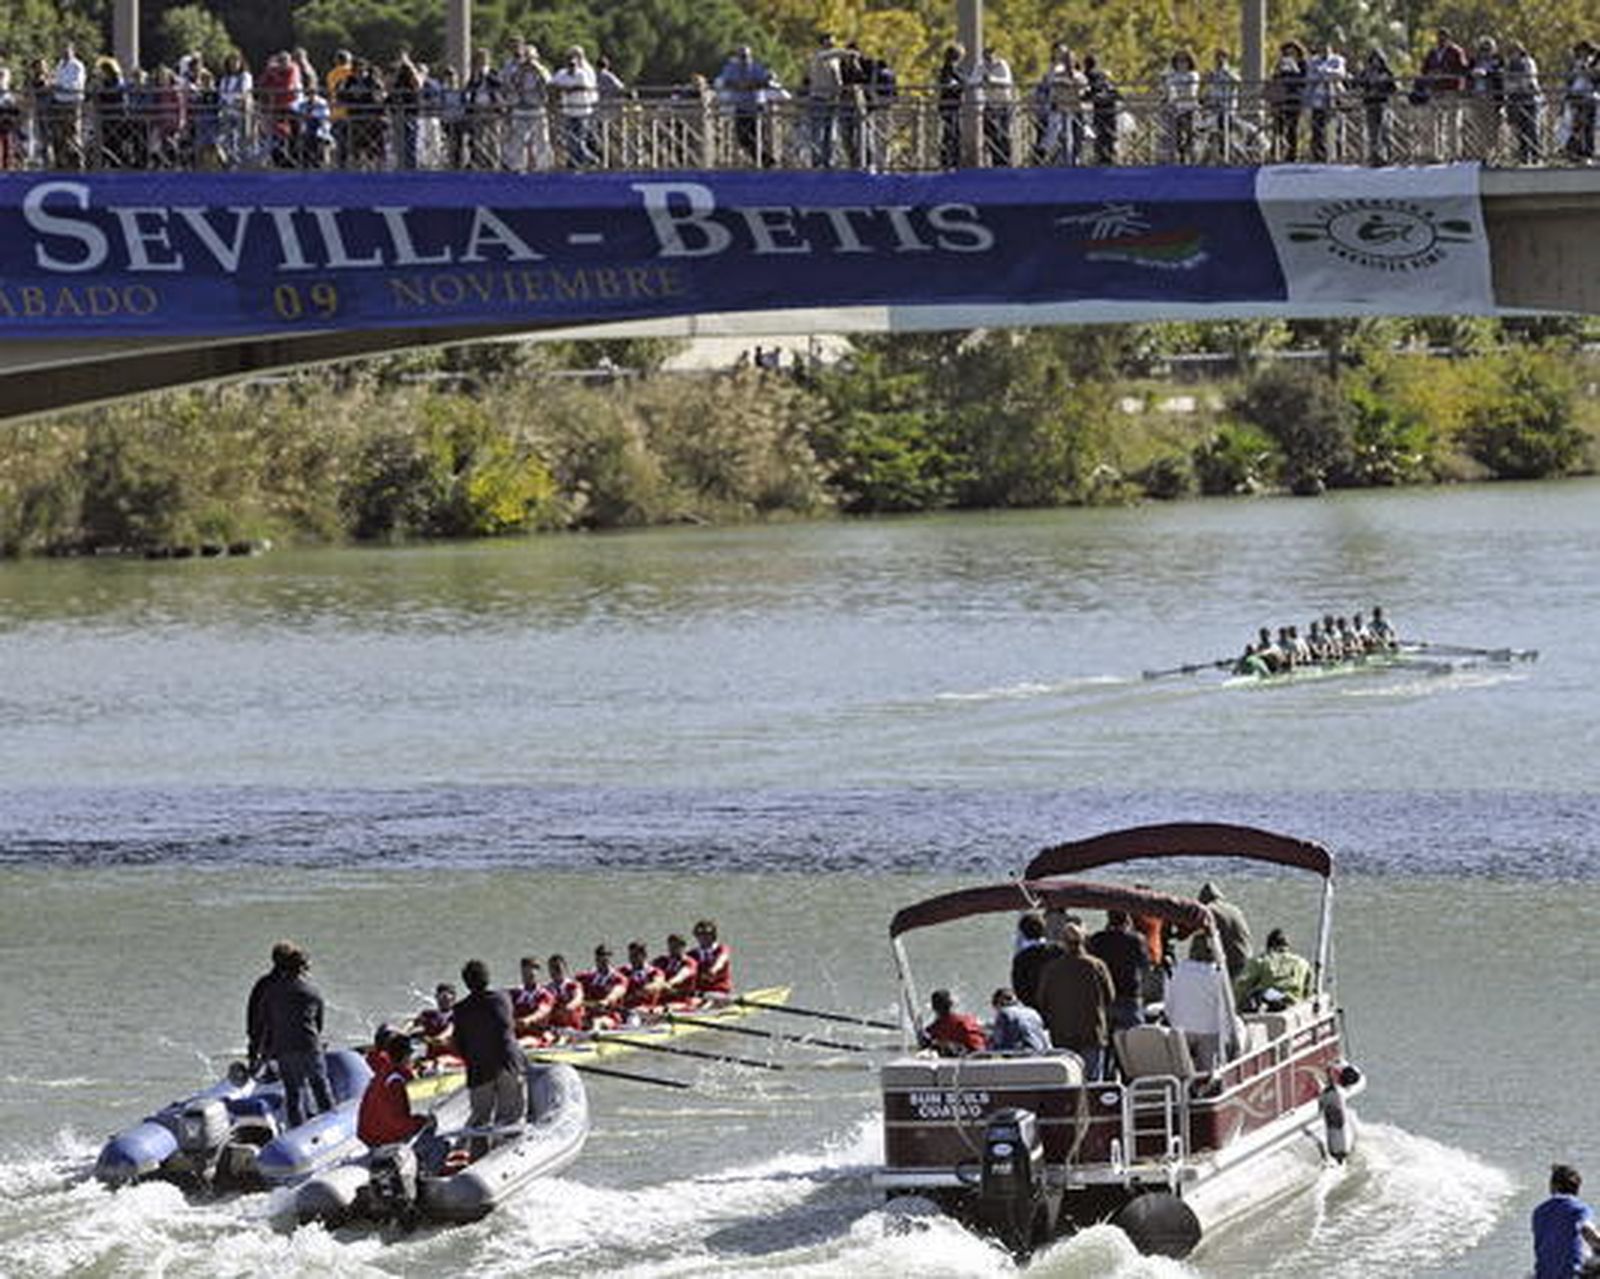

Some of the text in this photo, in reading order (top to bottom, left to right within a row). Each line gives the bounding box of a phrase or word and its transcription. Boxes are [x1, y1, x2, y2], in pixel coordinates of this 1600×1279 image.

[23, 181, 545, 273] SEVILLA
[632, 182, 995, 258] BETIS
[388, 266, 683, 305] NOVIEMBRE
